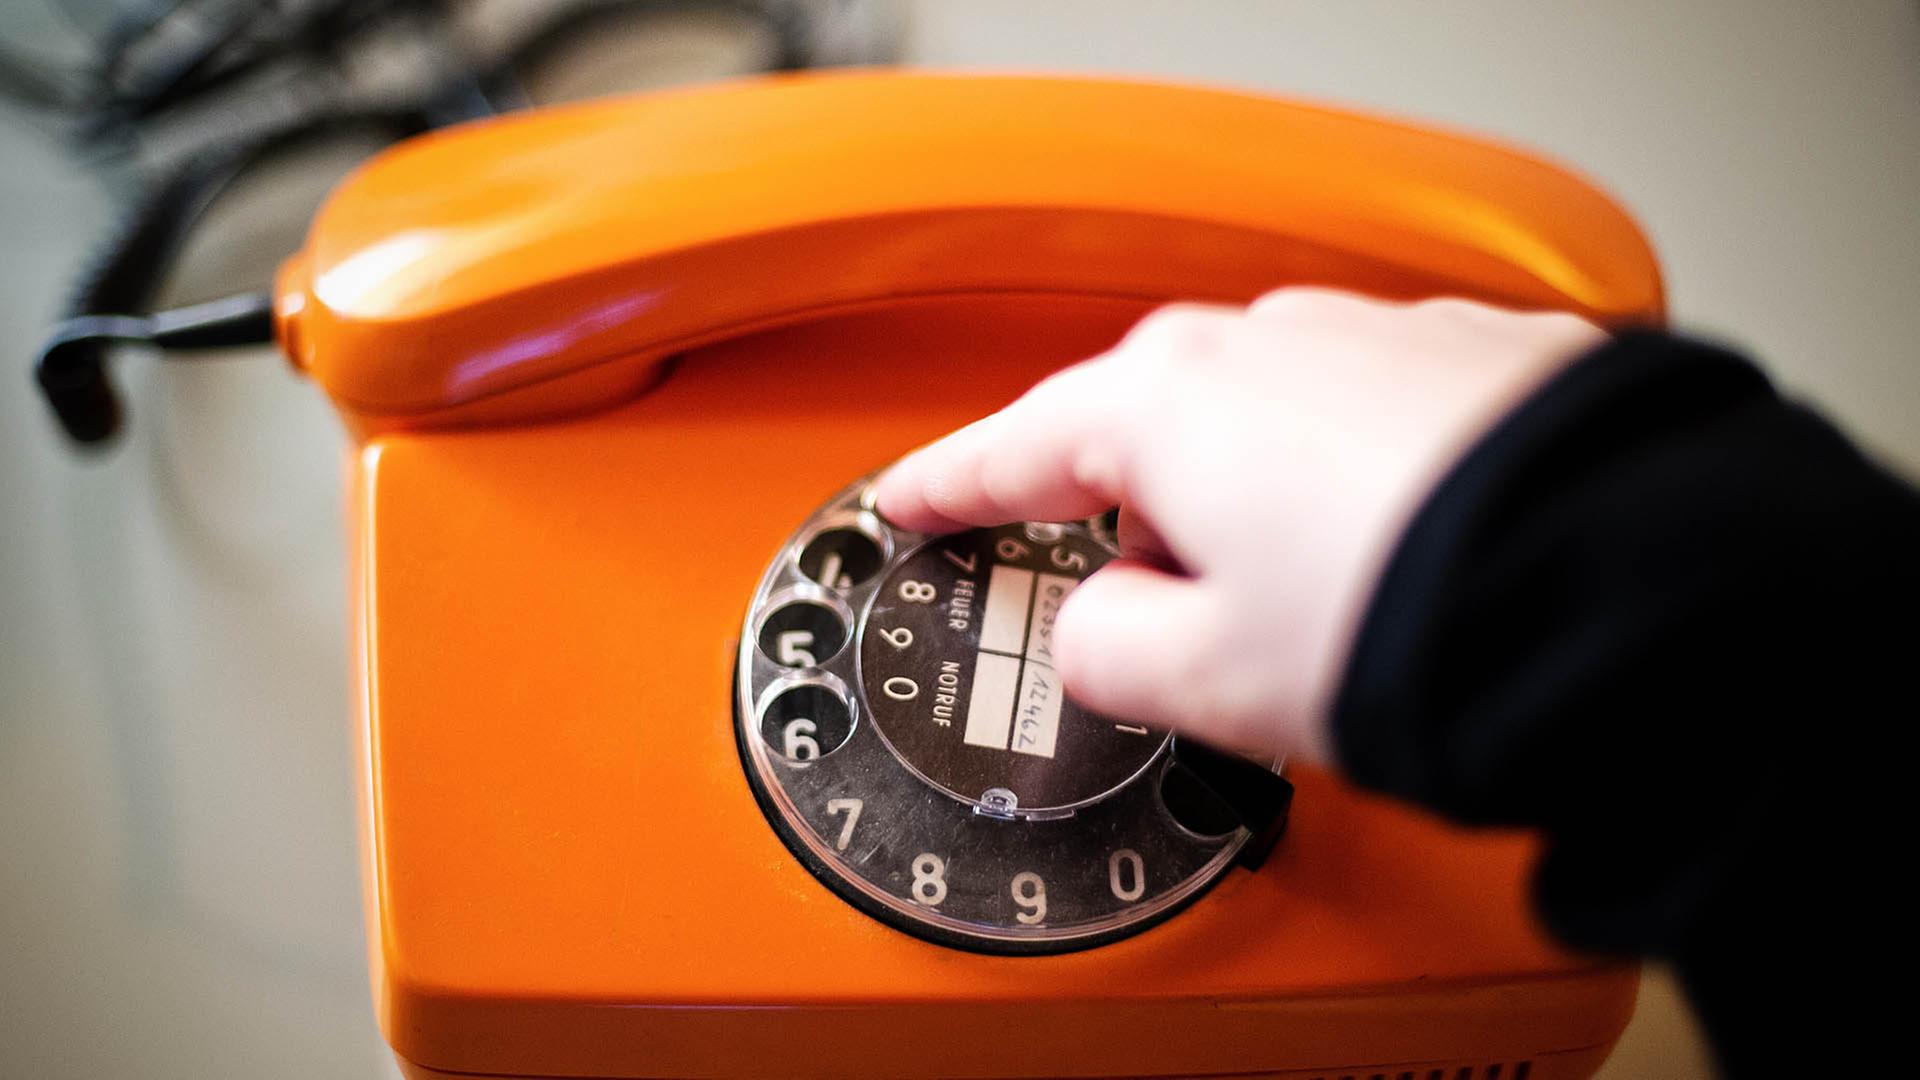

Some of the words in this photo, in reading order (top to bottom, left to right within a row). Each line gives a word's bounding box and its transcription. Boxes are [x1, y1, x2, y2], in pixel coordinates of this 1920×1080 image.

[943, 549, 978, 573] 7
[995, 537, 1030, 560] 6
[1050, 545, 1087, 572] 5
[899, 579, 937, 604] 8
[948, 579, 975, 632] FEUER
[777, 630, 817, 669] 5
[879, 627, 914, 650] 9
[882, 676, 919, 701] 0
[932, 660, 961, 728] NOTRUF
[783, 716, 821, 768] 6
[1114, 723, 1148, 736] 1
[827, 799, 864, 851] 7
[911, 852, 948, 906] 8
[1108, 849, 1146, 902] 0
[1010, 871, 1048, 925] 9
